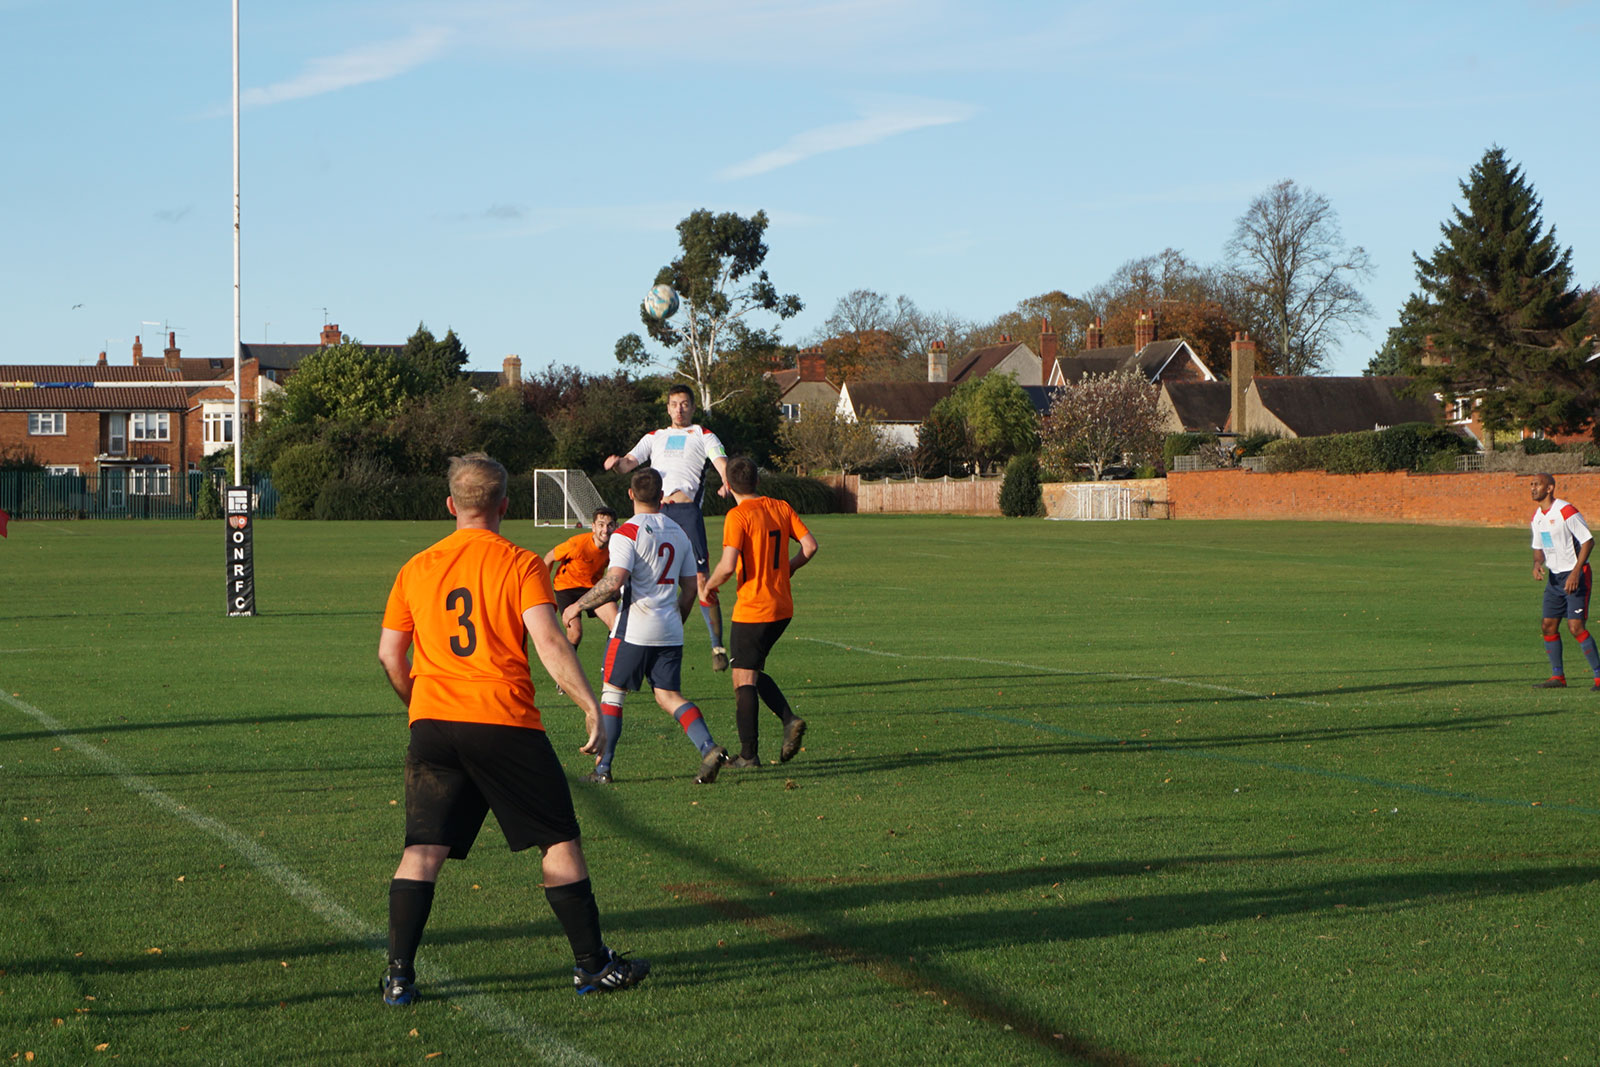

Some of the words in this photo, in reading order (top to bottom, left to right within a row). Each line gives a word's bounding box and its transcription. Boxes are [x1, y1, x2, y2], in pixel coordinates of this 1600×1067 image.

[233, 531, 245, 609] ONRFC
[656, 542, 675, 585] 2
[446, 587, 477, 657] 3
